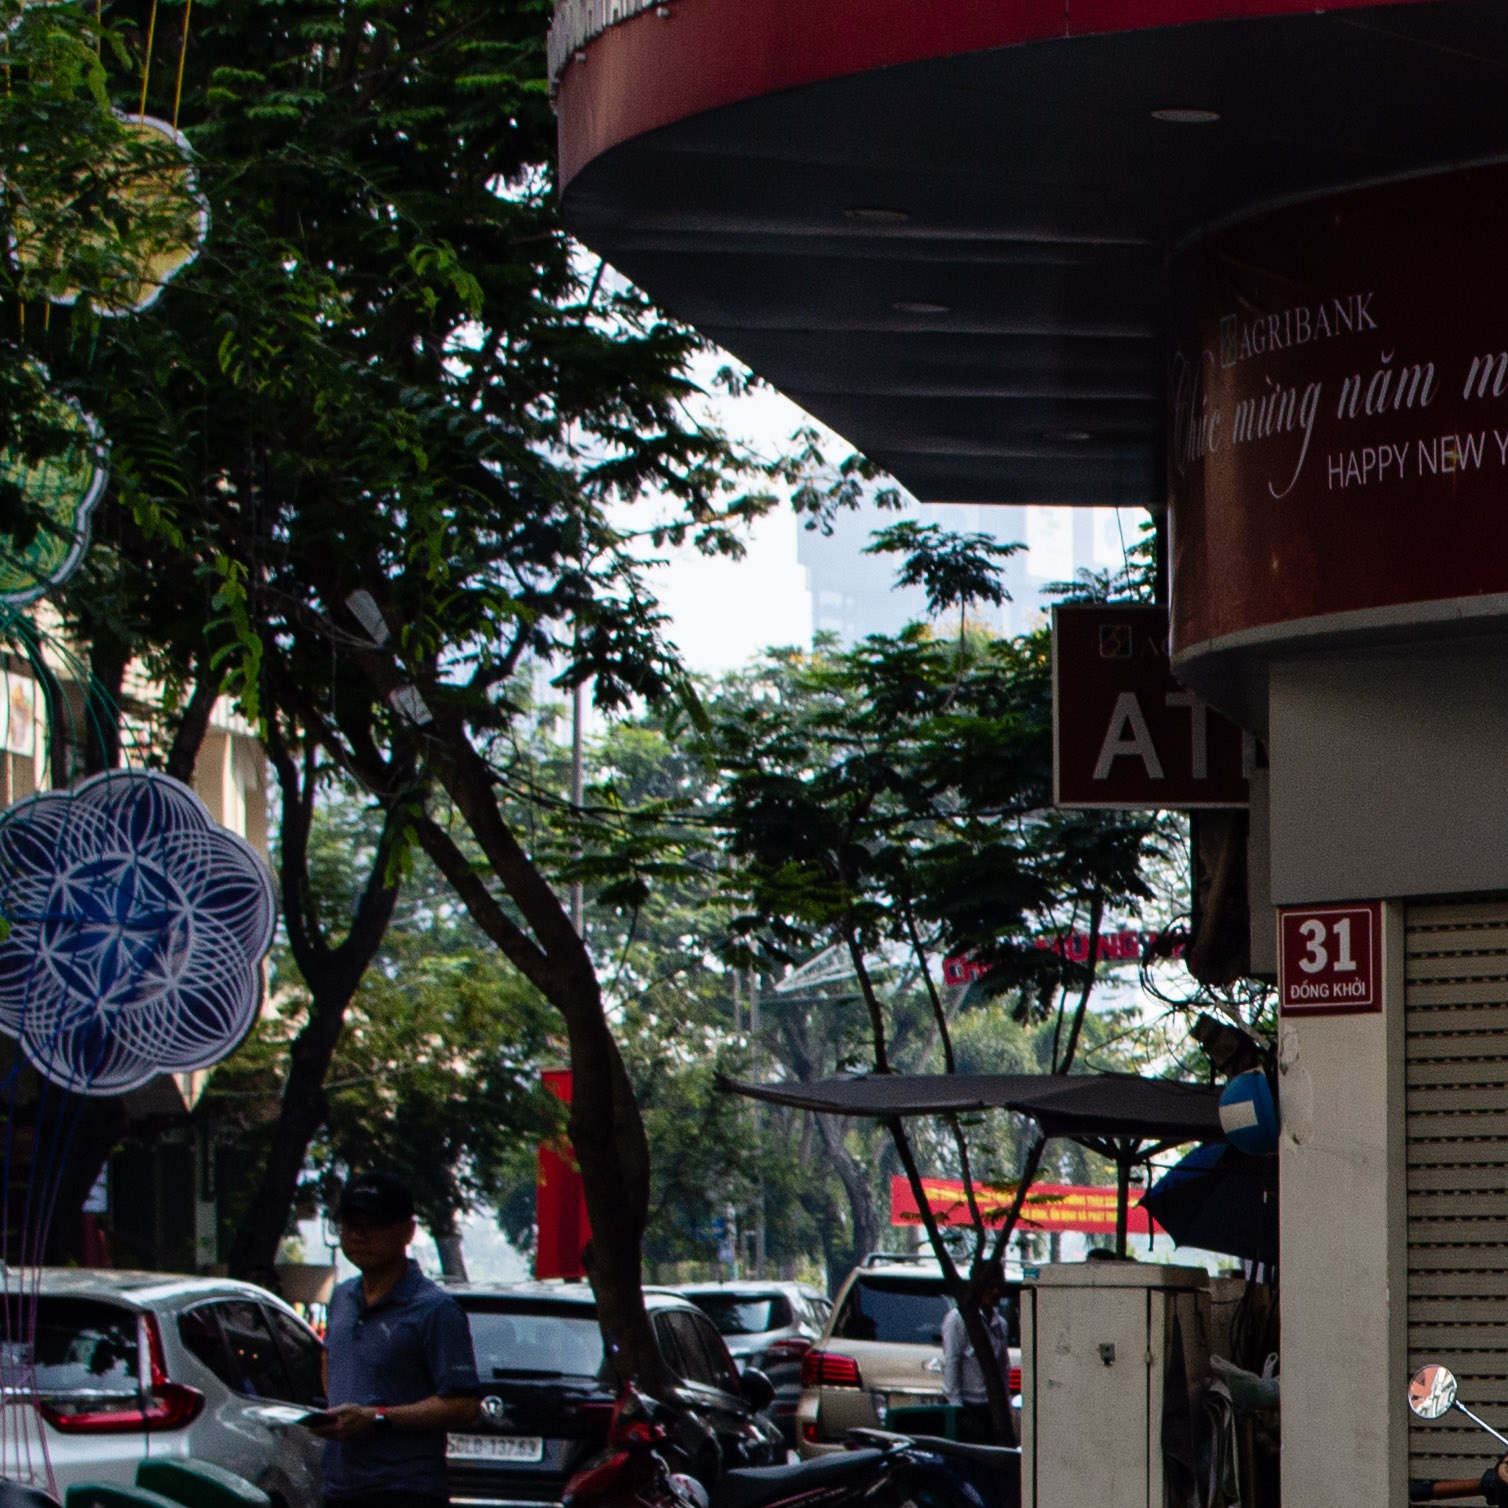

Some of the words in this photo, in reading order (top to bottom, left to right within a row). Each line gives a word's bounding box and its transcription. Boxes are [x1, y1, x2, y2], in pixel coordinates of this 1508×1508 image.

[1238, 291, 1379, 361] AGRIBANK
[1232, 374, 1323, 500] mừng
[1337, 345, 1440, 420] năm
[1327, 442, 1411, 491] HAPPY
[1417, 431, 1487, 478] NEW
[1298, 917, 1357, 975] 31
